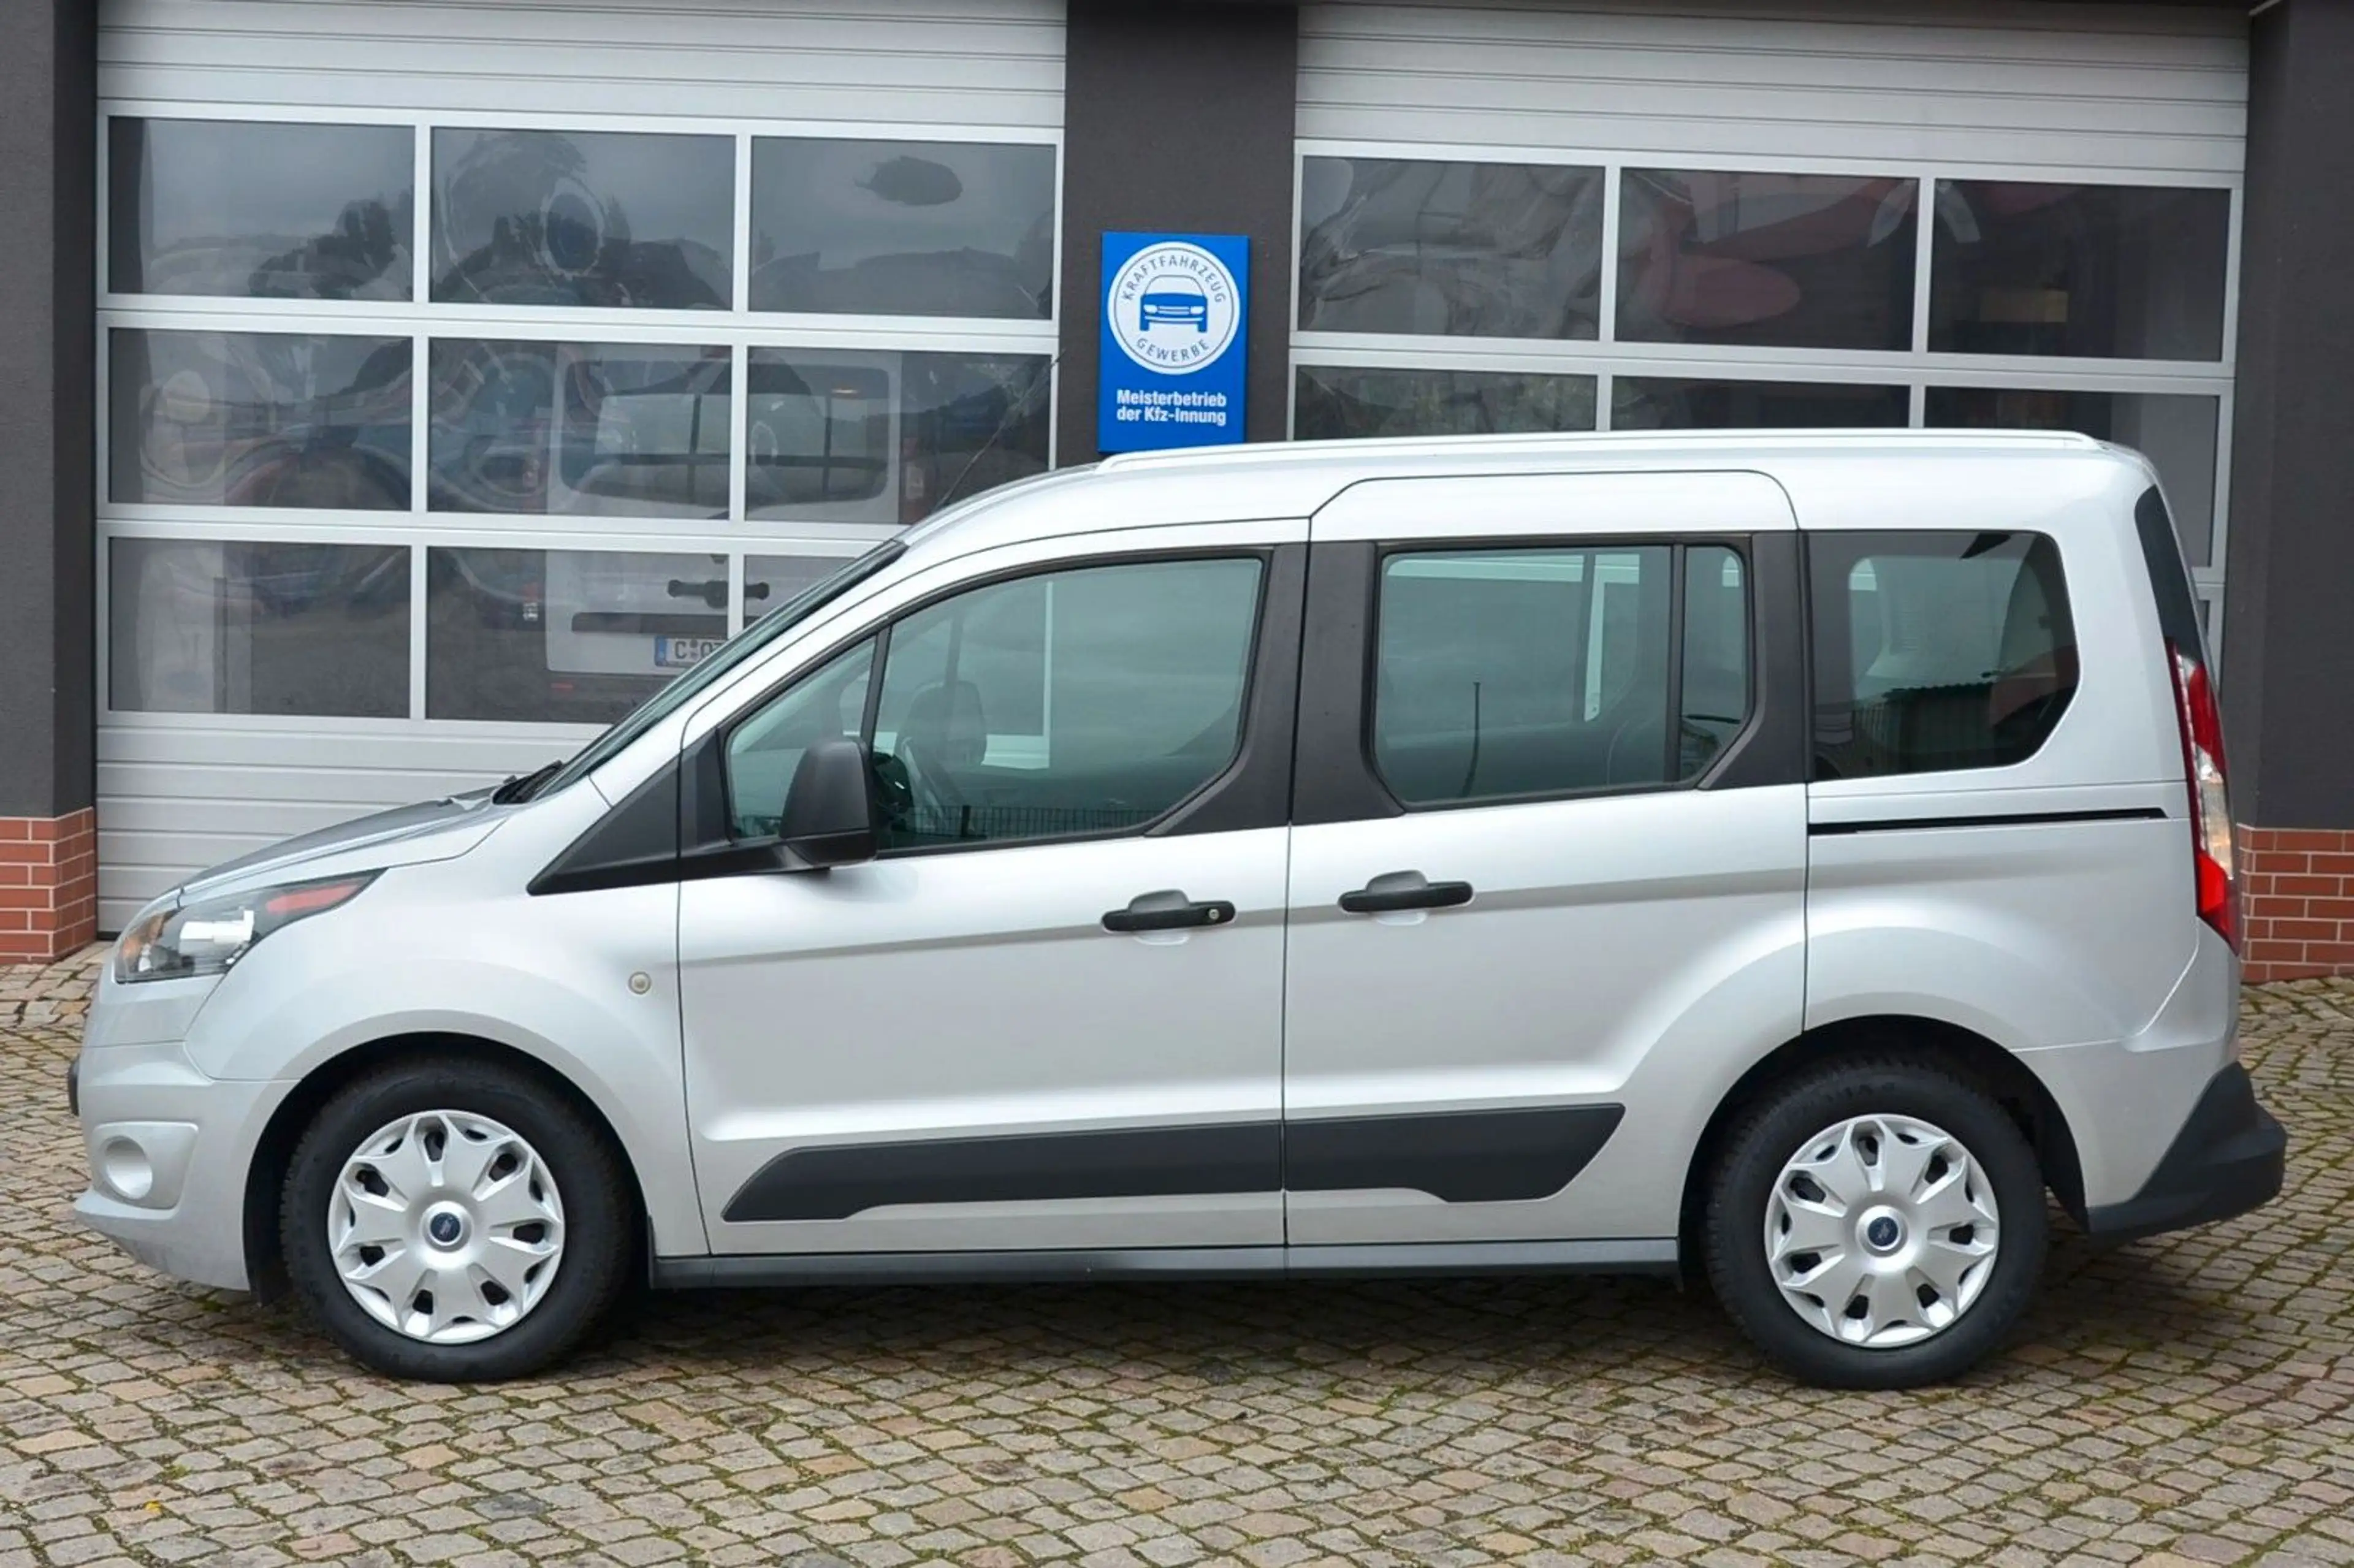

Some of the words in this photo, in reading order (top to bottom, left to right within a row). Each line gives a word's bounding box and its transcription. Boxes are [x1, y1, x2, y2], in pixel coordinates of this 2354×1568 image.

[1122, 255, 1226, 303] KRAFTFAHRZEUG
[1137, 338, 1209, 362] GEWERBE
[1117, 389, 1227, 407] Meisterbetrieb
[1117, 406, 1141, 421] der
[1145, 406, 1226, 427] Kfz-Innung
